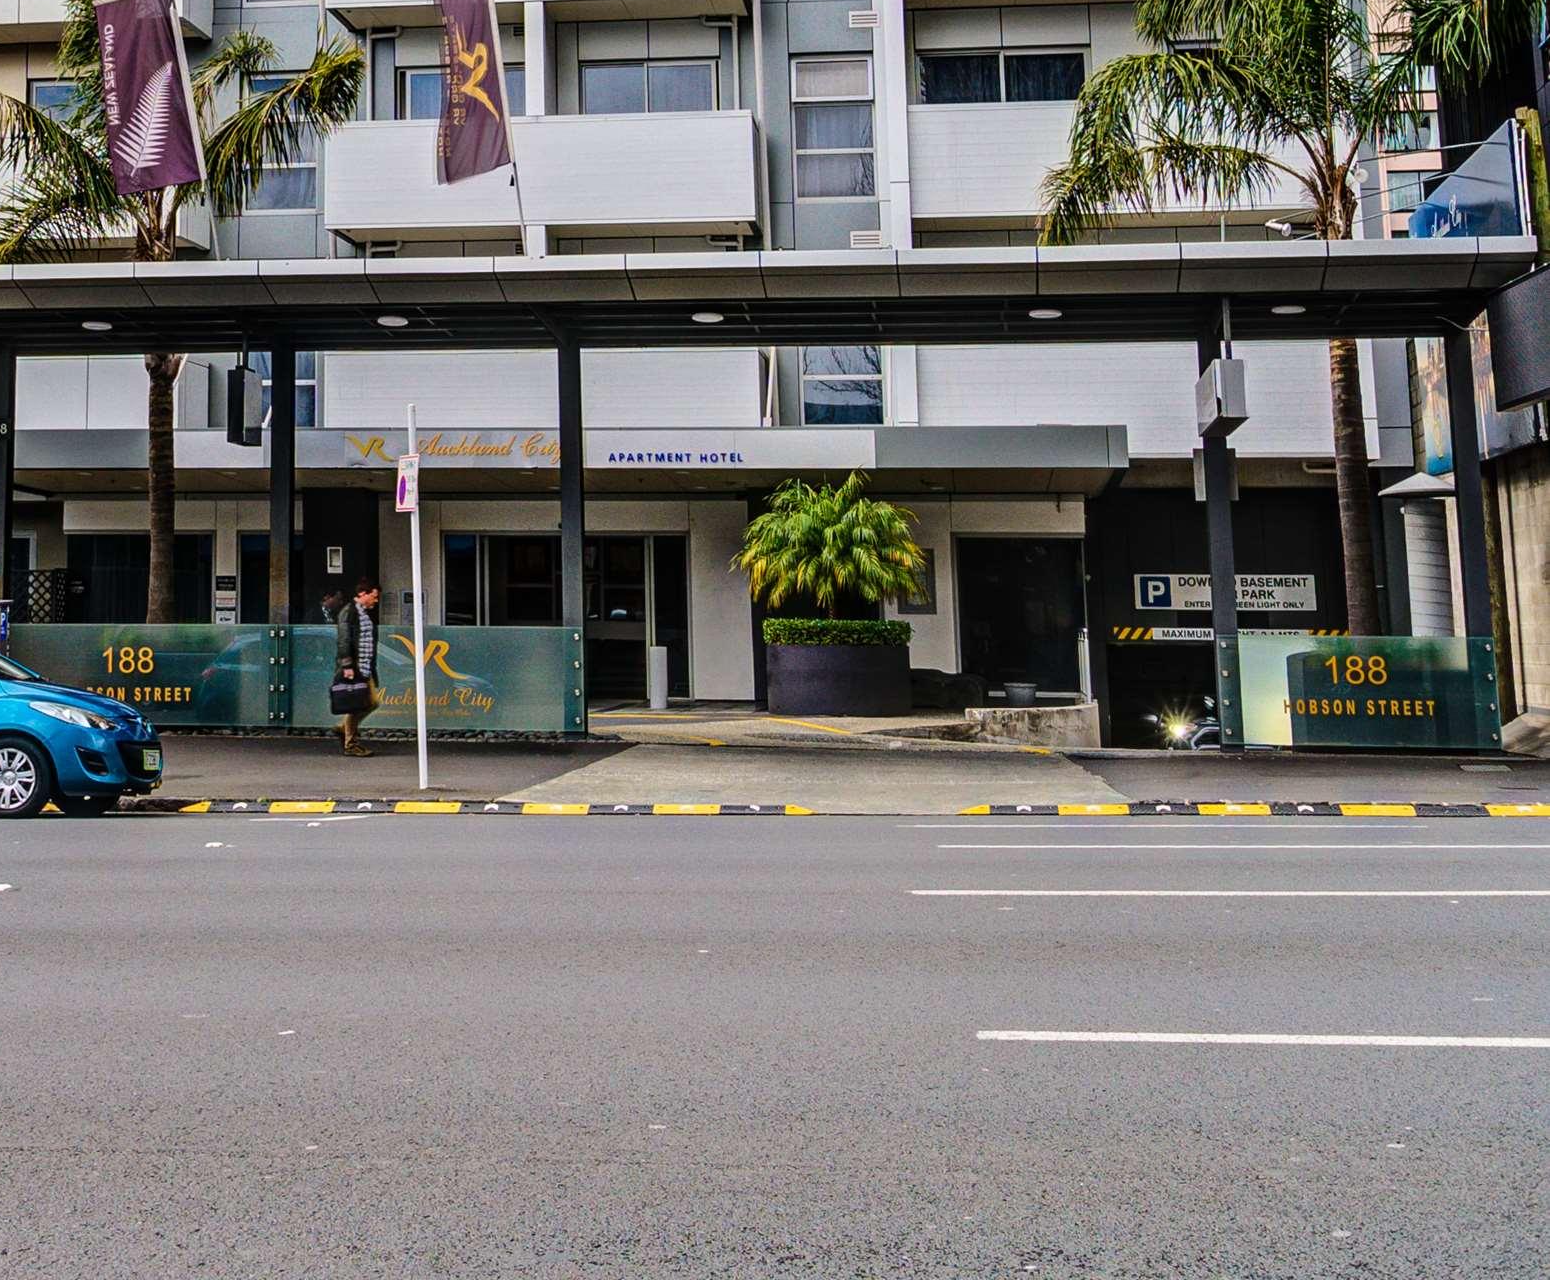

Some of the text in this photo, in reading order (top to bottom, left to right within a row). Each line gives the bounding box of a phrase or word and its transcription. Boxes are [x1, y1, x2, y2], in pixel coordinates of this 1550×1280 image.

[418, 431, 517, 458] Auckland
[520, 431, 562, 465] City
[608, 452, 744, 463] APARTMENT HOTEL
[1240, 577, 1308, 588] BASEMENT
[1147, 580, 1165, 604] P
[1241, 589, 1276, 600] PARK
[1184, 600, 1211, 608] ENTER
[1161, 629, 1212, 639] MAXIMUM
[102, 646, 154, 674] 188
[1325, 655, 1388, 685] 188
[134, 687, 192, 701] STREET
[453, 687, 495, 713] City
[1283, 699, 1435, 716] HOBSON STREET
